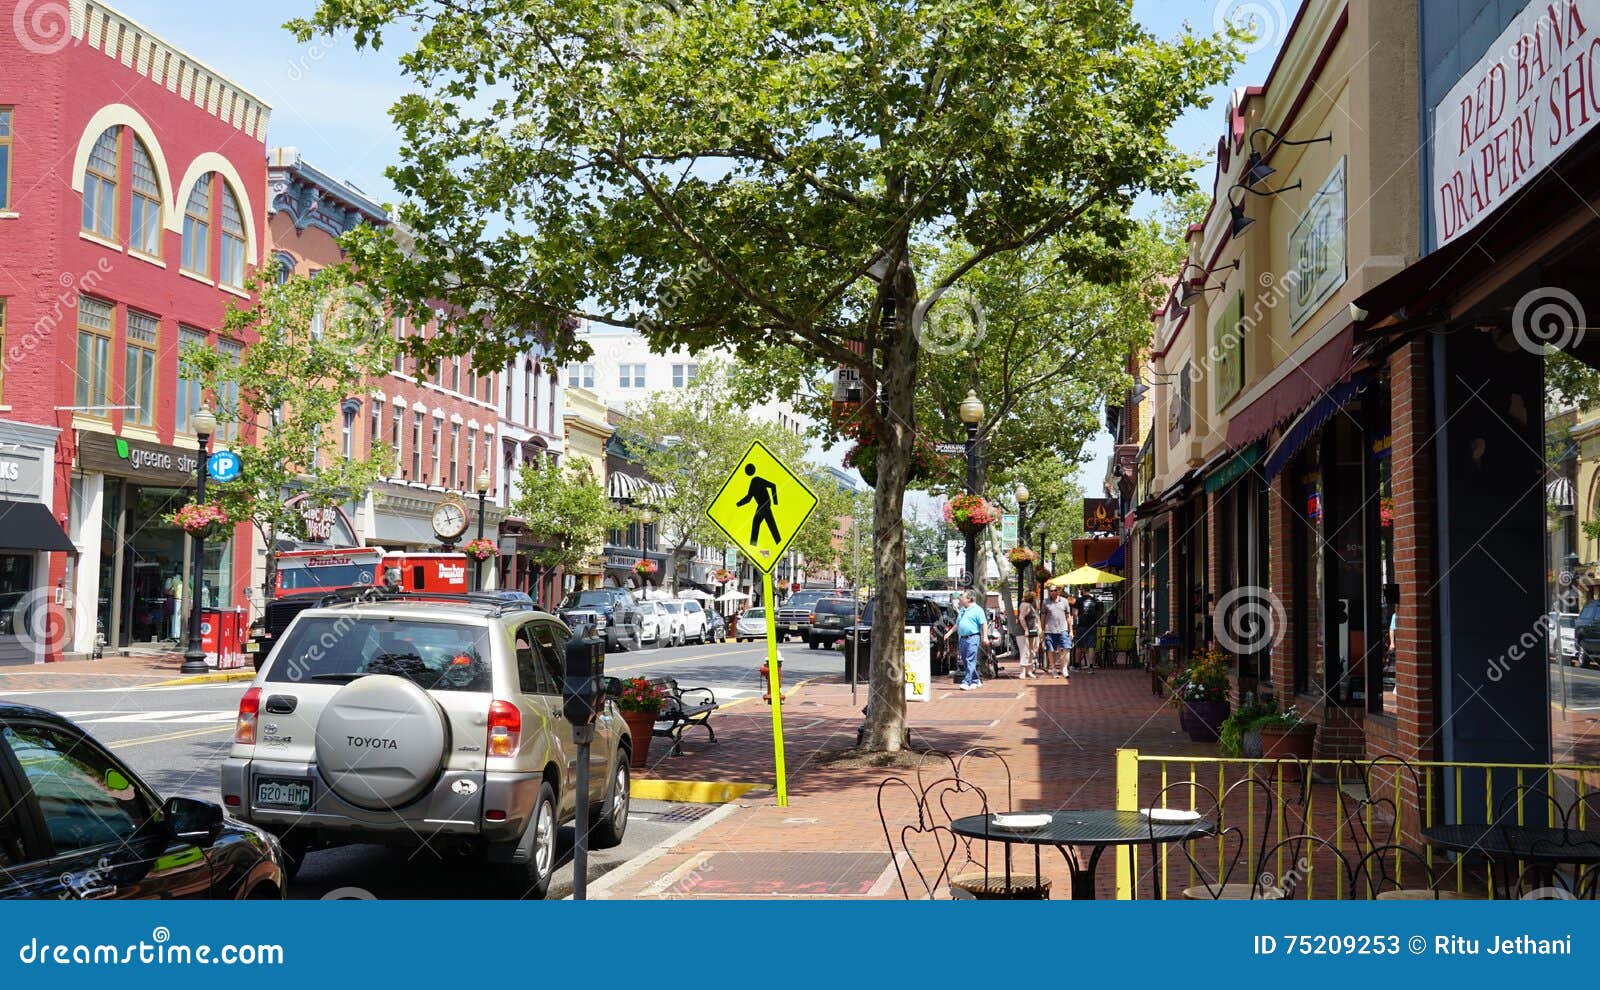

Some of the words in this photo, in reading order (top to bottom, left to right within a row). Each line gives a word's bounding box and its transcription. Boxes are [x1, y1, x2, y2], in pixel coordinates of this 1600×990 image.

[1458, 63, 1505, 157] RED
[1516, 0, 1587, 104] BANK
[1440, 96, 1540, 241] DRAPERY
[839, 370, 860, 381] FIL
[131, 449, 171, 469] greene
[308, 557, 351, 567] Dunbar
[346, 736, 398, 750] TOYOTA
